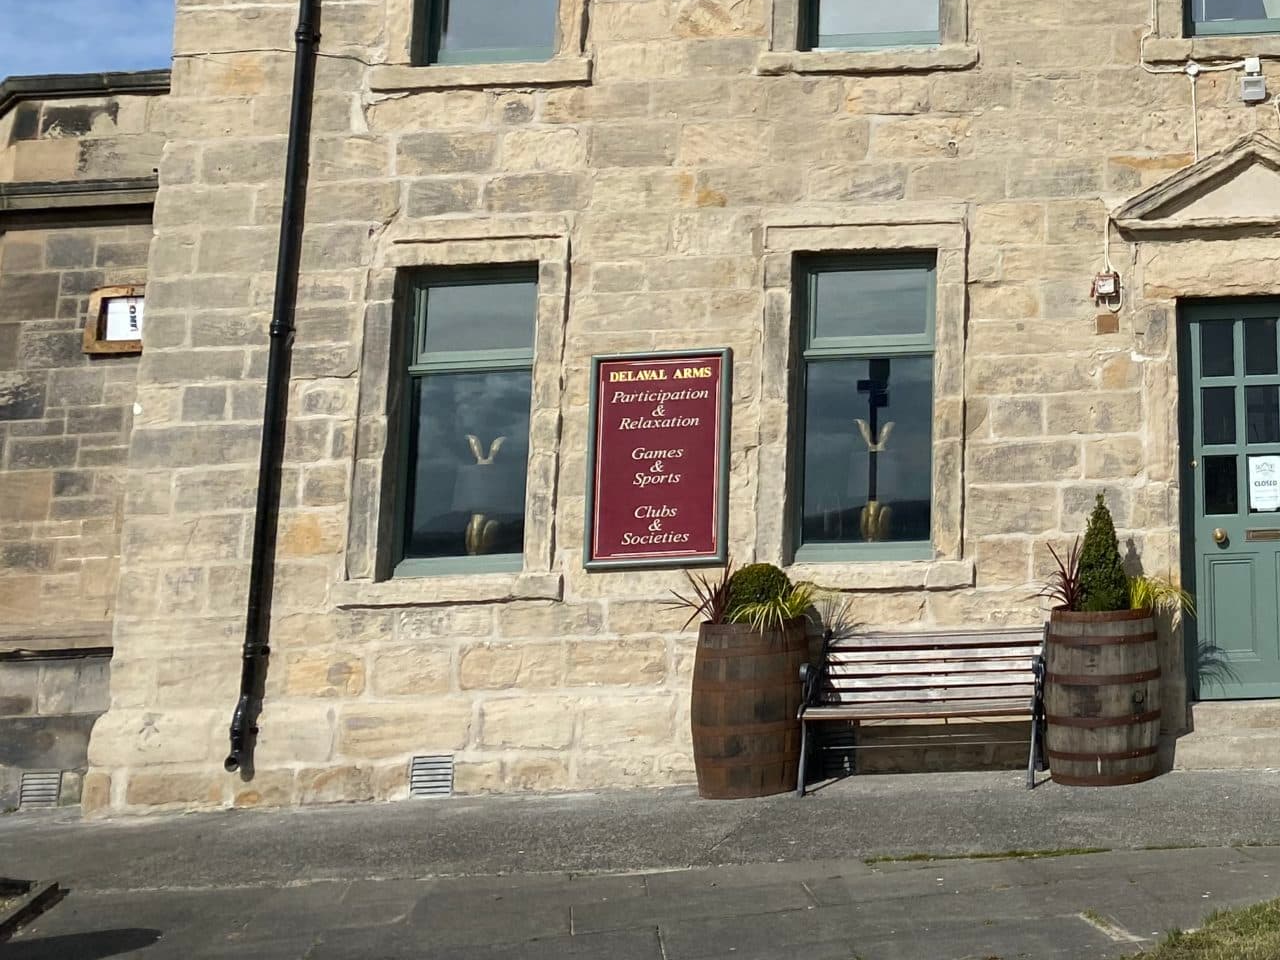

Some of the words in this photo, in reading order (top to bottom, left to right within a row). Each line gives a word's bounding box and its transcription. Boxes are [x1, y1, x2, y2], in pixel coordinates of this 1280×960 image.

[609, 369, 667, 383] DELAVAL
[673, 367, 712, 380] ARMS
[611, 388, 709, 404] Participation
[651, 405, 666, 417] &
[619, 416, 700, 430] Relaxation
[631, 447, 684, 460] Games
[649, 460, 665, 473] &
[632, 472, 681, 488] Sports
[634, 504, 678, 519] Clubs
[648, 519, 663, 532] &
[621, 531, 690, 545] Societies
